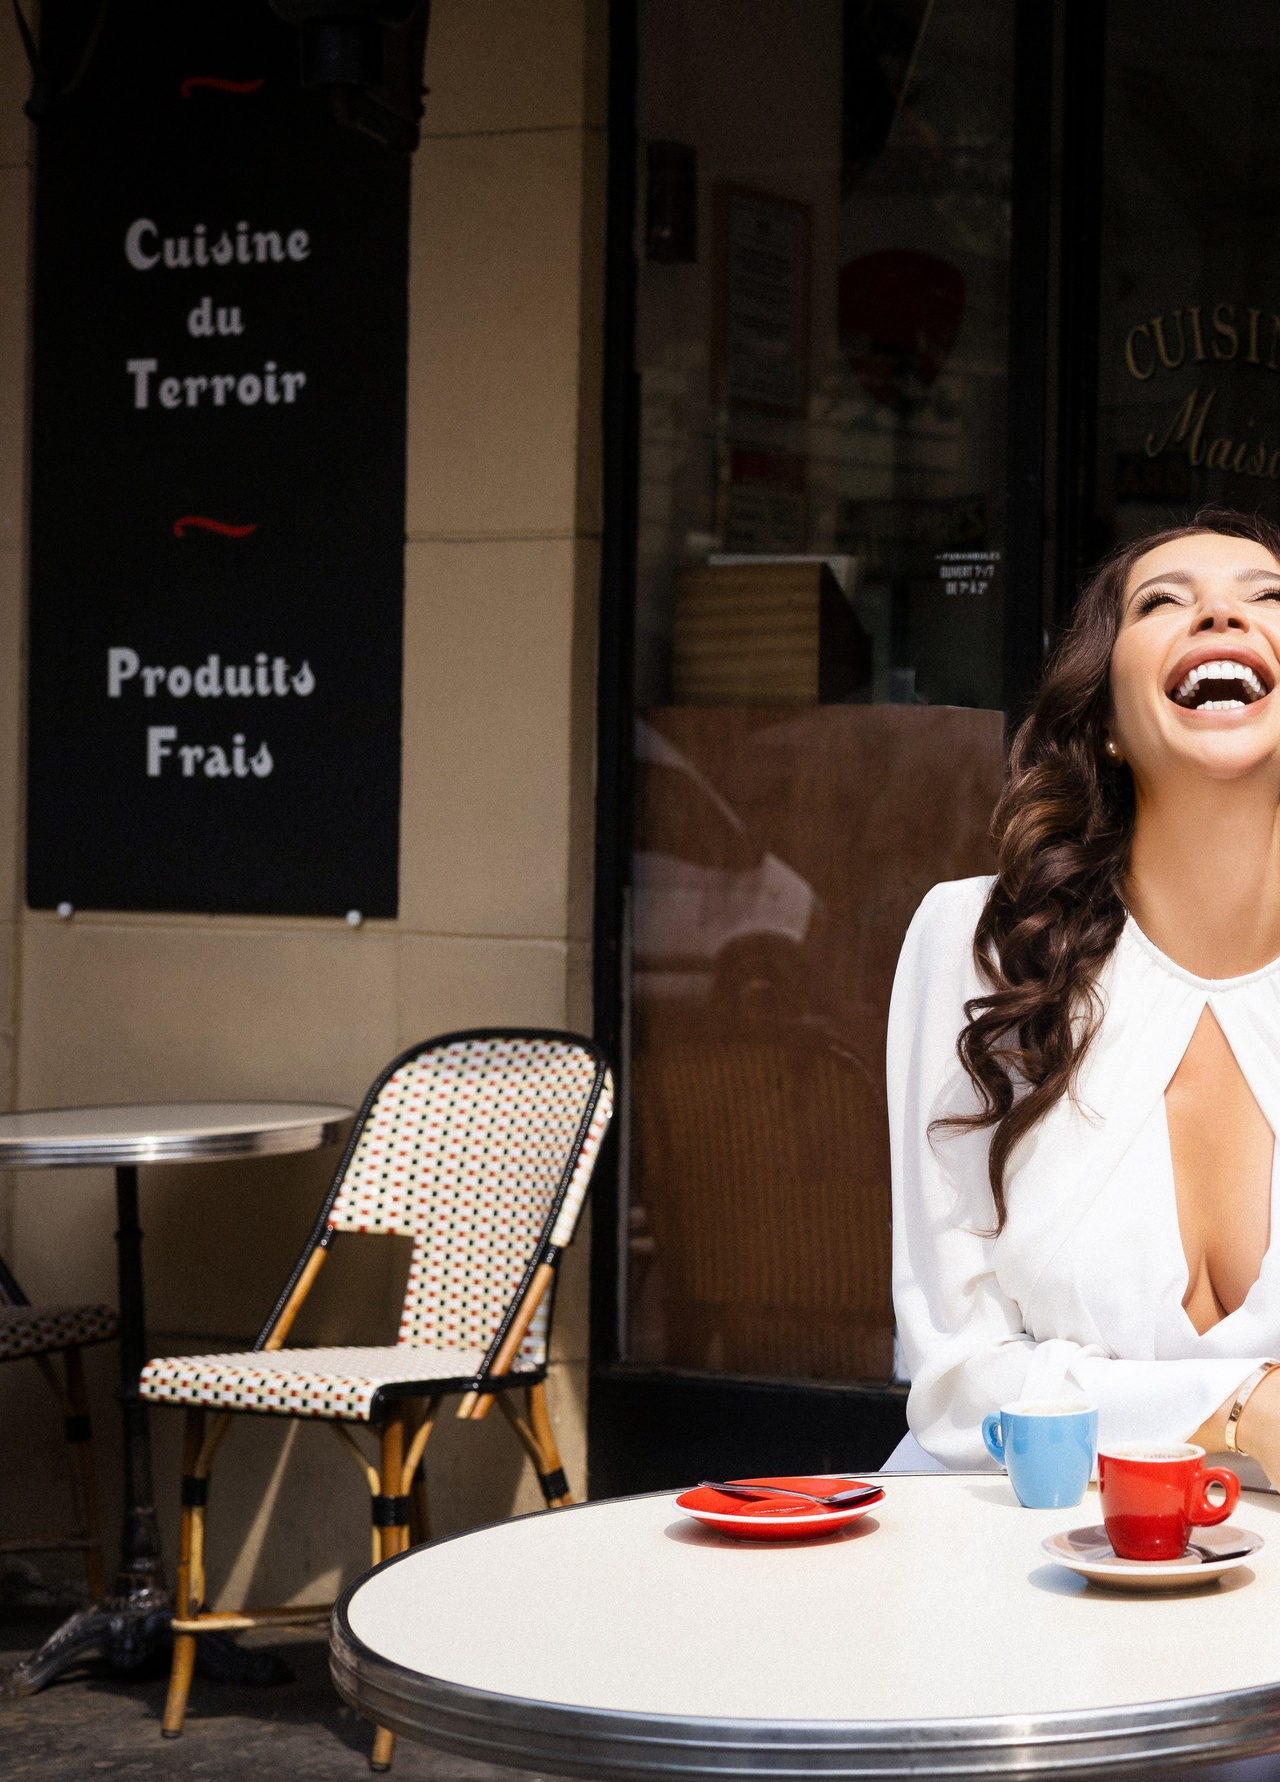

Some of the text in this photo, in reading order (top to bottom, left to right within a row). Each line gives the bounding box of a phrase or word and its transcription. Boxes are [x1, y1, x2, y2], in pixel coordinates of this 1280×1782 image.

[124, 217, 311, 271] Cuisine
[187, 296, 244, 337] du
[126, 357, 307, 409] Terroir
[106, 646, 317, 698] Produits
[146, 725, 274, 778] Frais
